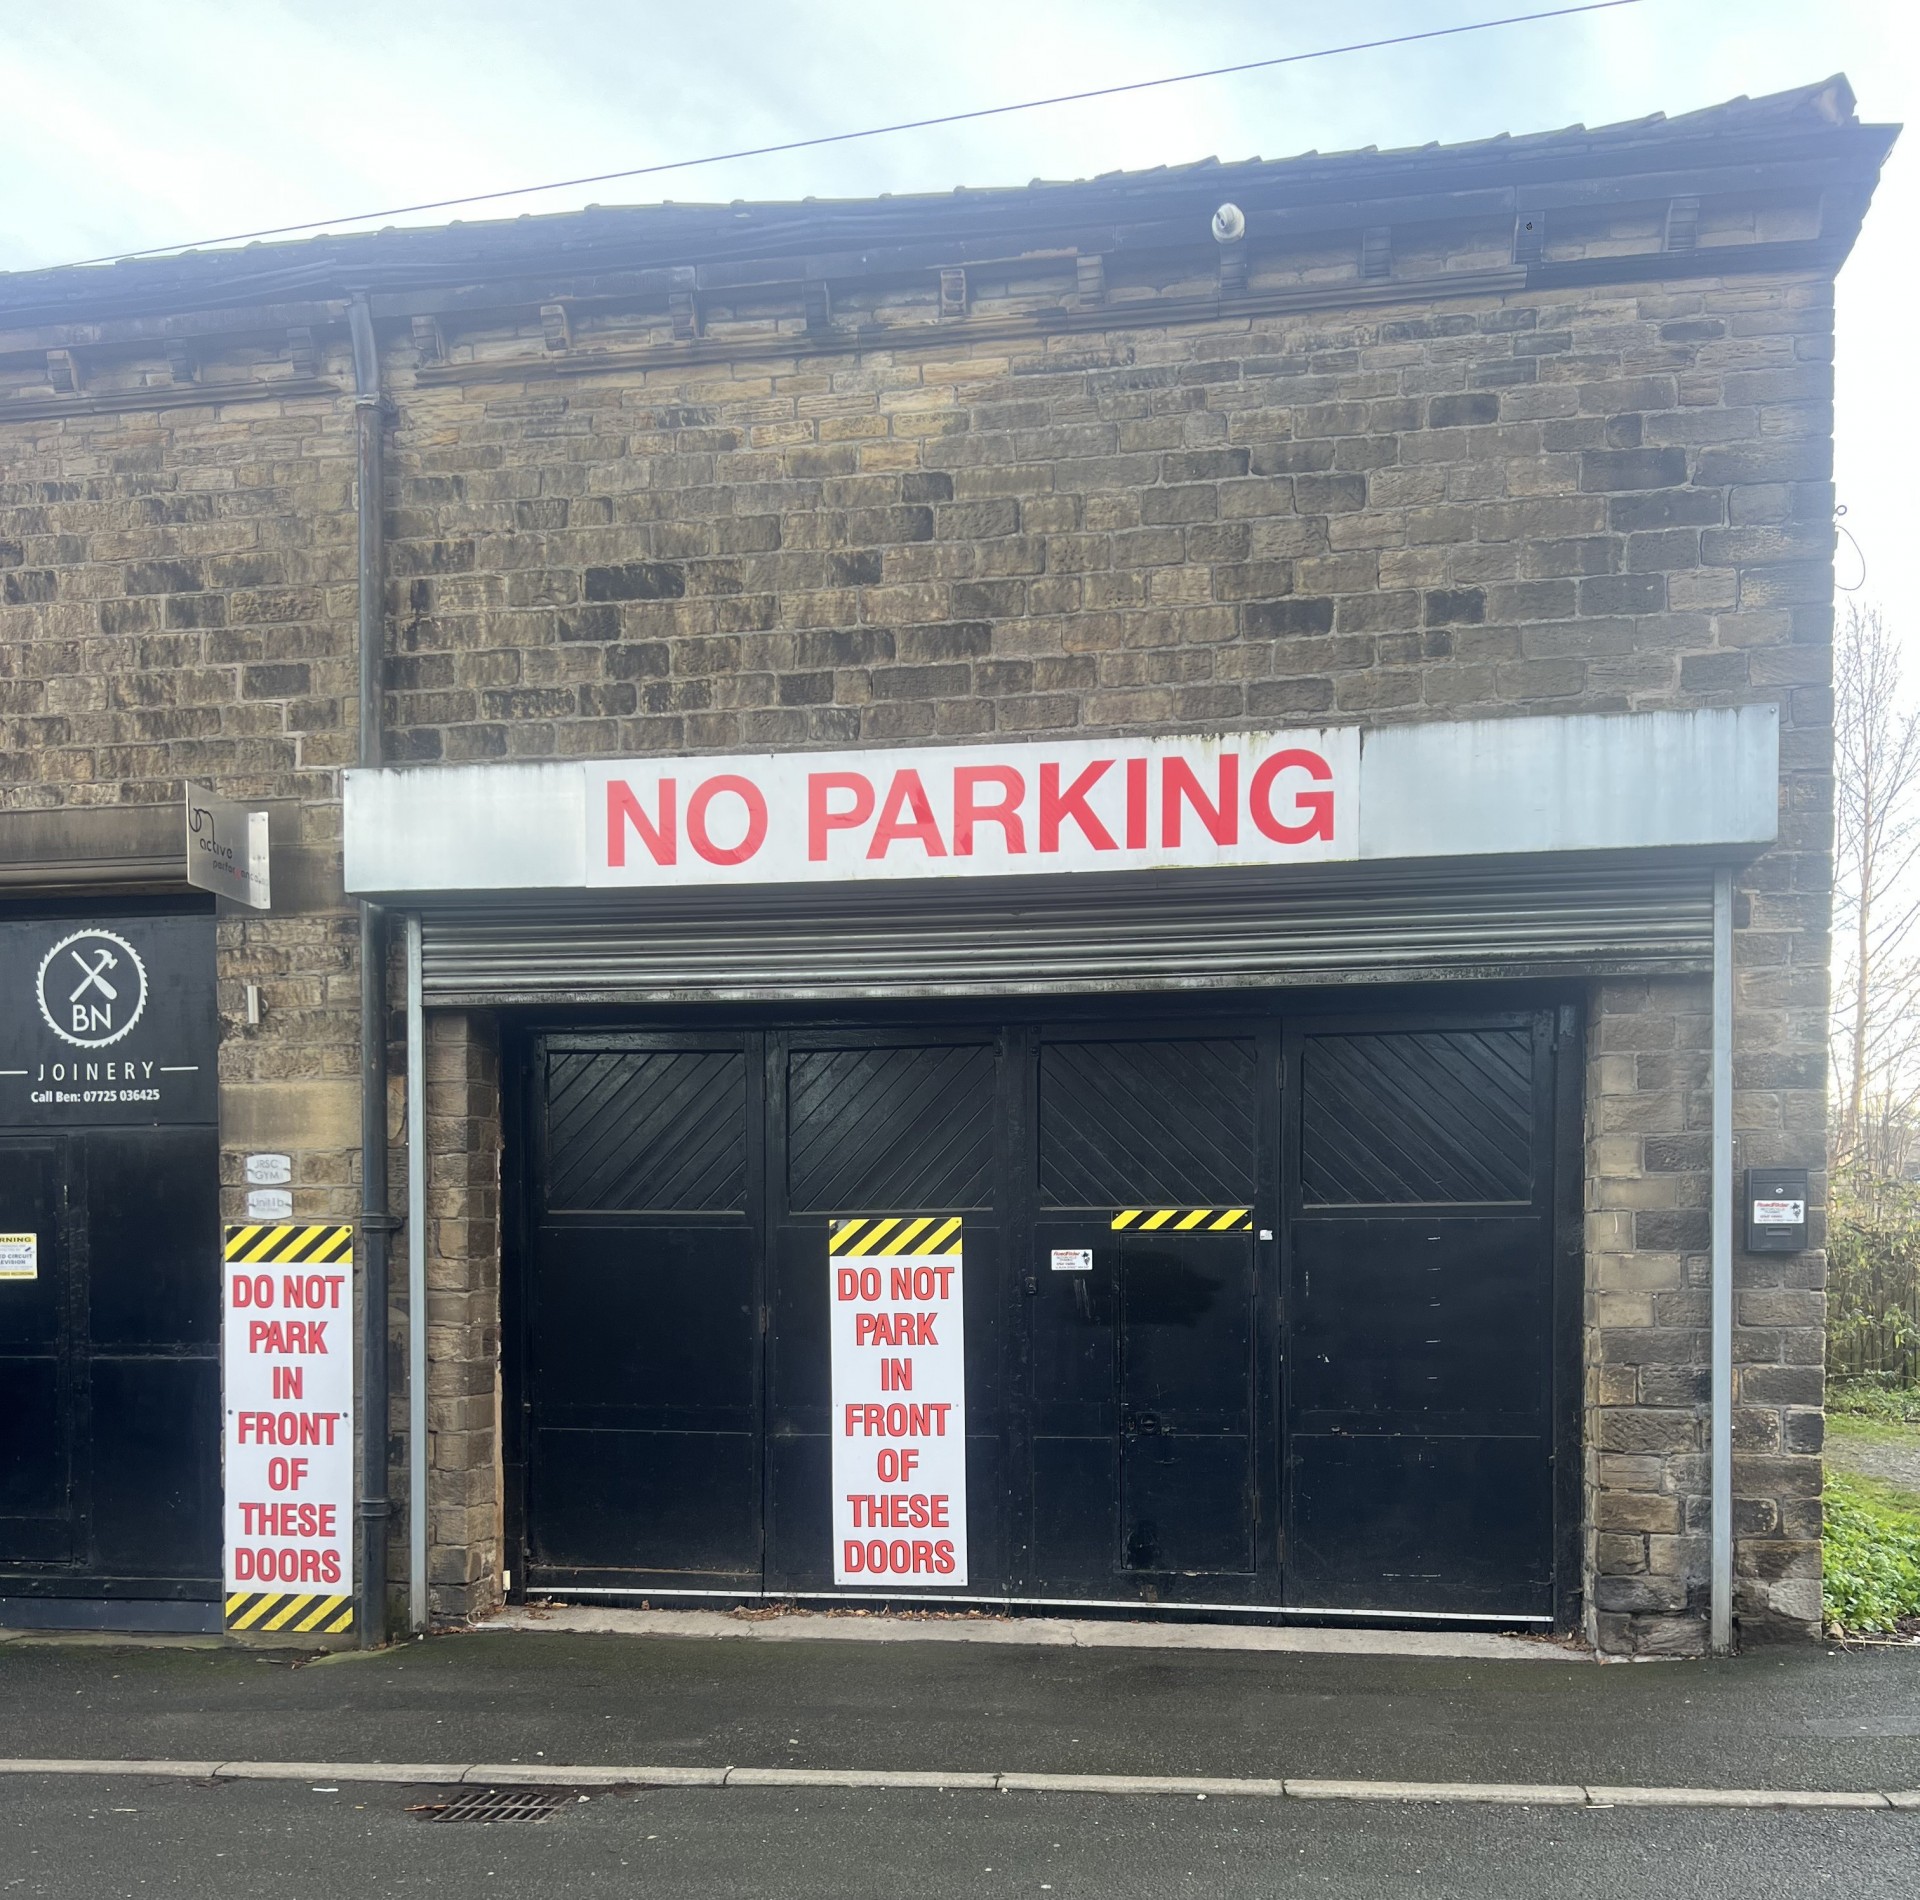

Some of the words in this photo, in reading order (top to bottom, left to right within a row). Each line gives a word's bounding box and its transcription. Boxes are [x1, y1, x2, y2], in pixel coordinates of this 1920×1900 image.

[608, 774, 769, 868] NO
[808, 748, 1335, 862] PARKING
[200, 838, 232, 859] active
[73, 1004, 112, 1032] BN
[38, 1061, 153, 1081] JOINERY
[31, 1091, 53, 1103] Call
[56, 1090, 81, 1103] Ben:
[83, 1090, 117, 1102] 07725
[120, 1089, 160, 1101] 036425
[255, 1171, 280, 1180] GYM
[232, 1275, 275, 1309] DO
[283, 1275, 345, 1309] NOT
[837, 1268, 882, 1302] DO
[890, 1266, 954, 1301] NOT
[249, 1320, 327, 1354] PARK
[855, 1312, 938, 1346] PARK
[272, 1367, 303, 1400] IN
[881, 1358, 913, 1391] IN
[238, 1412, 341, 1446] FRONT
[845, 1403, 951, 1437] FRONT
[268, 1457, 308, 1491] OF
[877, 1449, 919, 1483] OF
[239, 1502, 336, 1538] THESE
[847, 1494, 949, 1529] THESE
[235, 1547, 341, 1583] DOORS
[843, 1540, 956, 1575] DOORS
